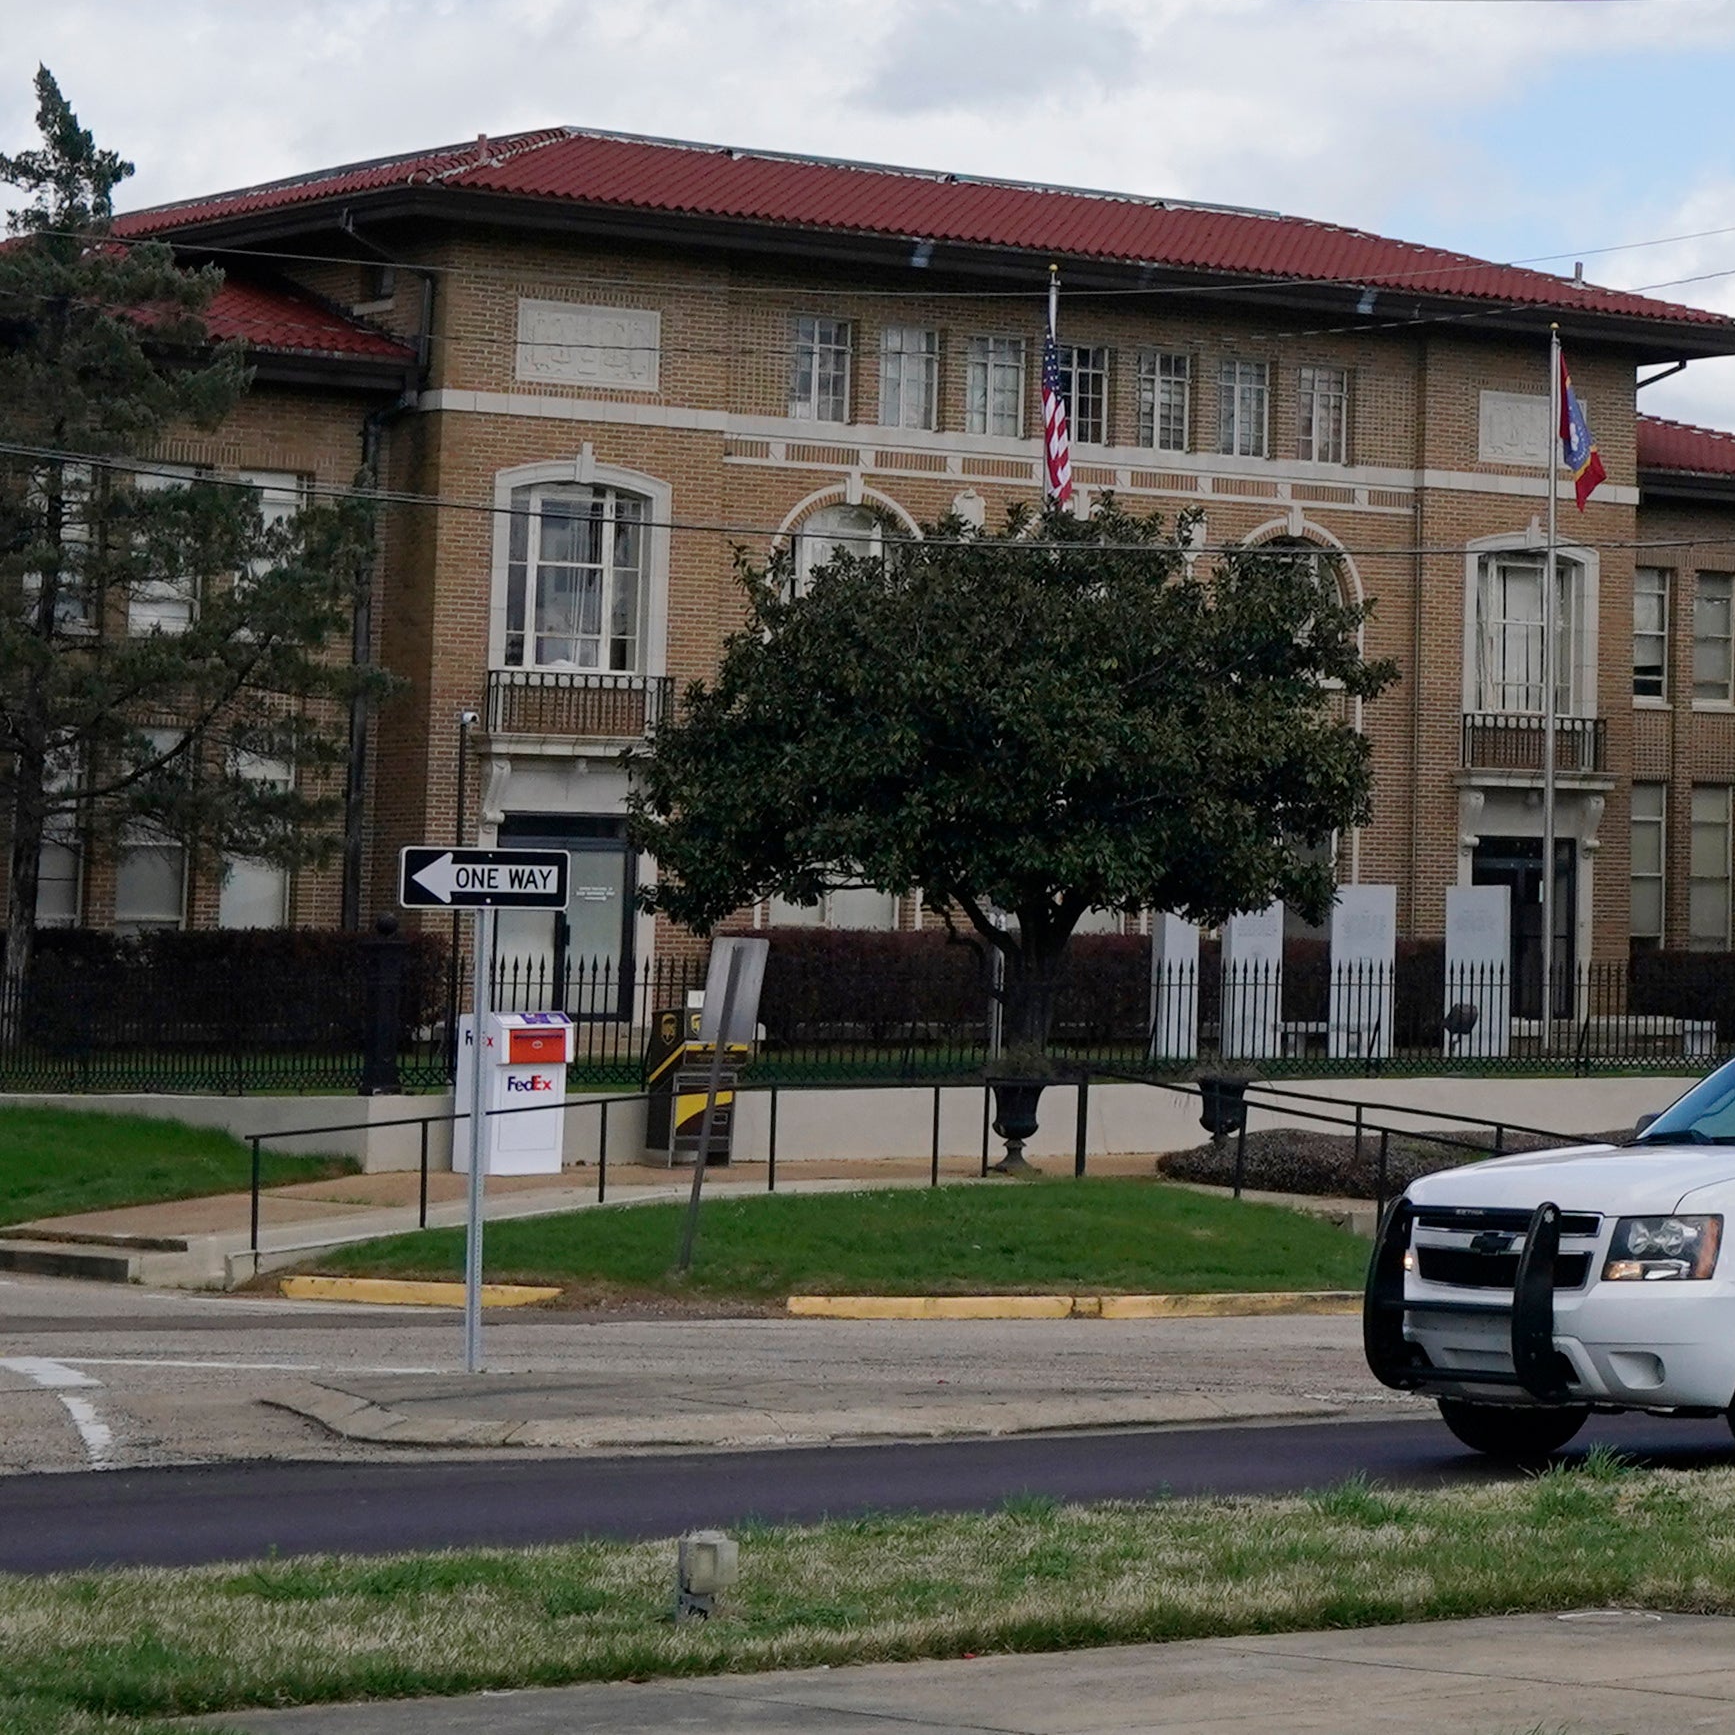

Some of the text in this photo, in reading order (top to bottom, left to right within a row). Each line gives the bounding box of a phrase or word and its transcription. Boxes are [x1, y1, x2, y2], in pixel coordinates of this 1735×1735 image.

[456, 867, 553, 890] ONE WAY
[507, 1075, 552, 1092] FedEx
